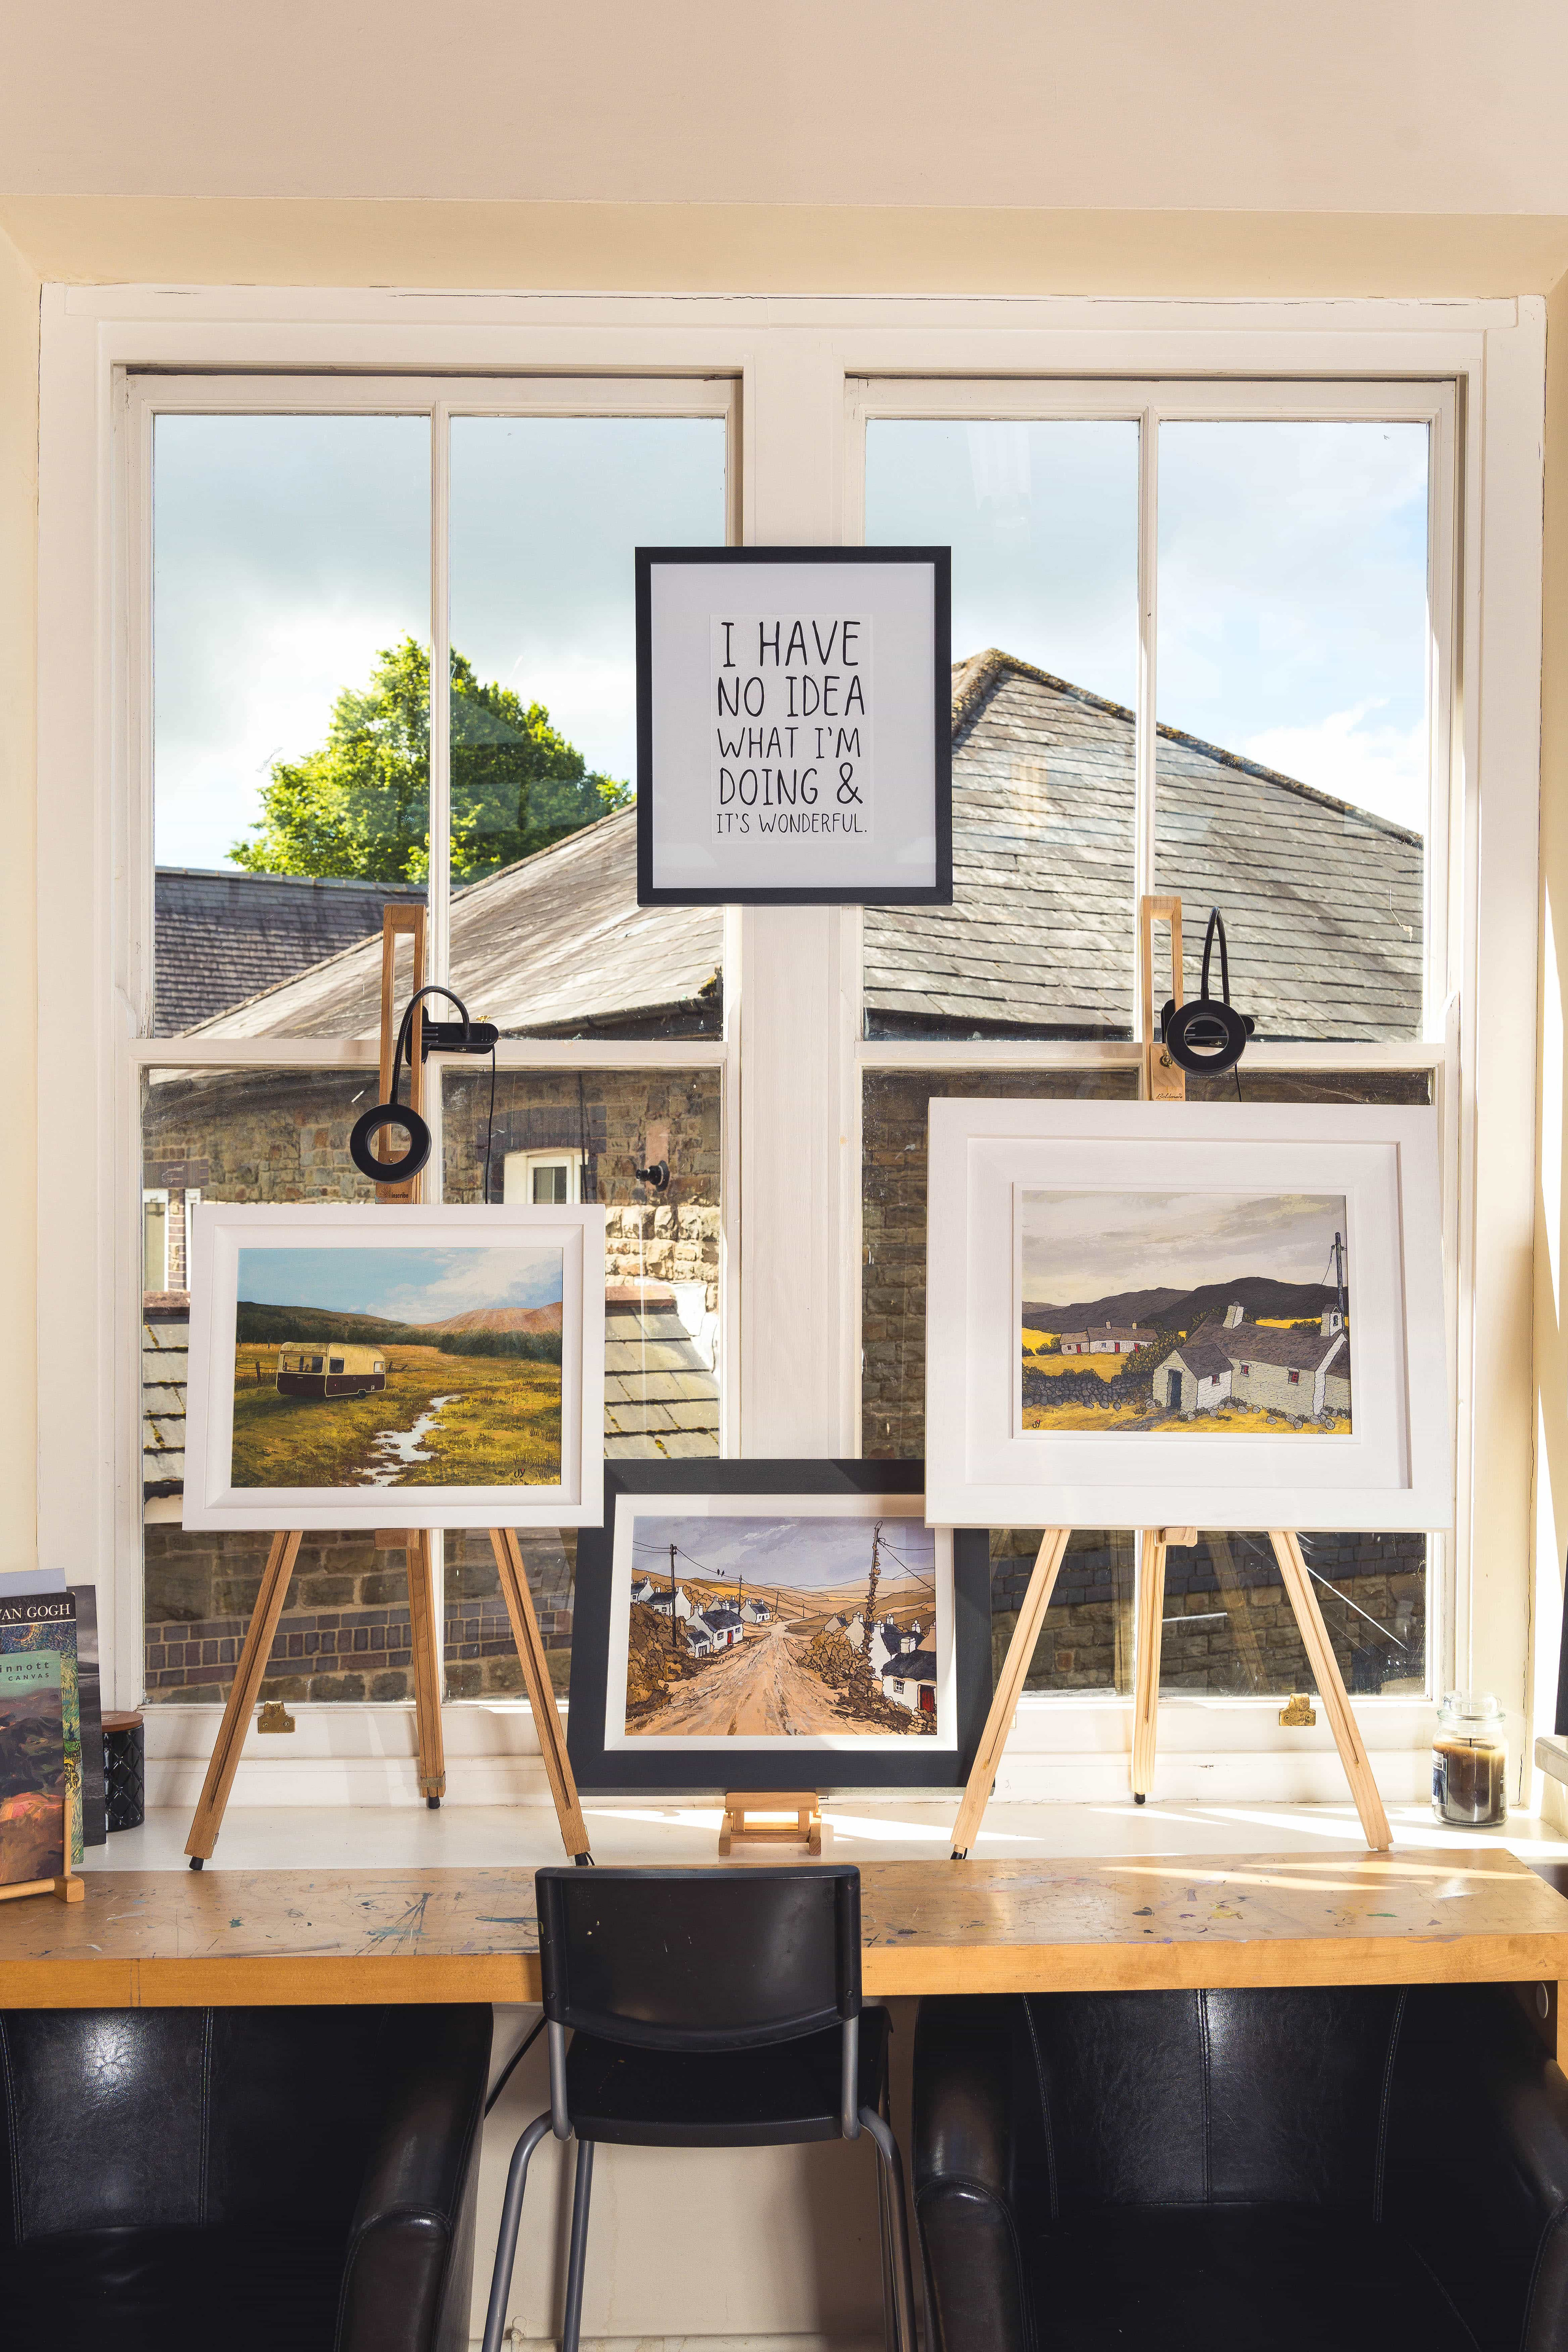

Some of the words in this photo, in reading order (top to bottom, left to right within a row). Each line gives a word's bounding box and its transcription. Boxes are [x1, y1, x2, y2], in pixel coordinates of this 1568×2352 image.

[721, 622, 736, 668] I
[759, 620, 861, 667] HAVE
[717, 676, 765, 717] NO
[785, 675, 865, 717] IDEA
[717, 726, 799, 759] WHAT
[814, 726, 861, 759] I'M
[720, 767, 818, 806] DOING
[836, 762, 863, 804] &
[717, 813, 750, 833] IT'S
[759, 813, 868, 833] WONDERFUL.
[27, 1604, 70, 1618] GOGH
[8, 1673, 49, 1681] CANVAS
